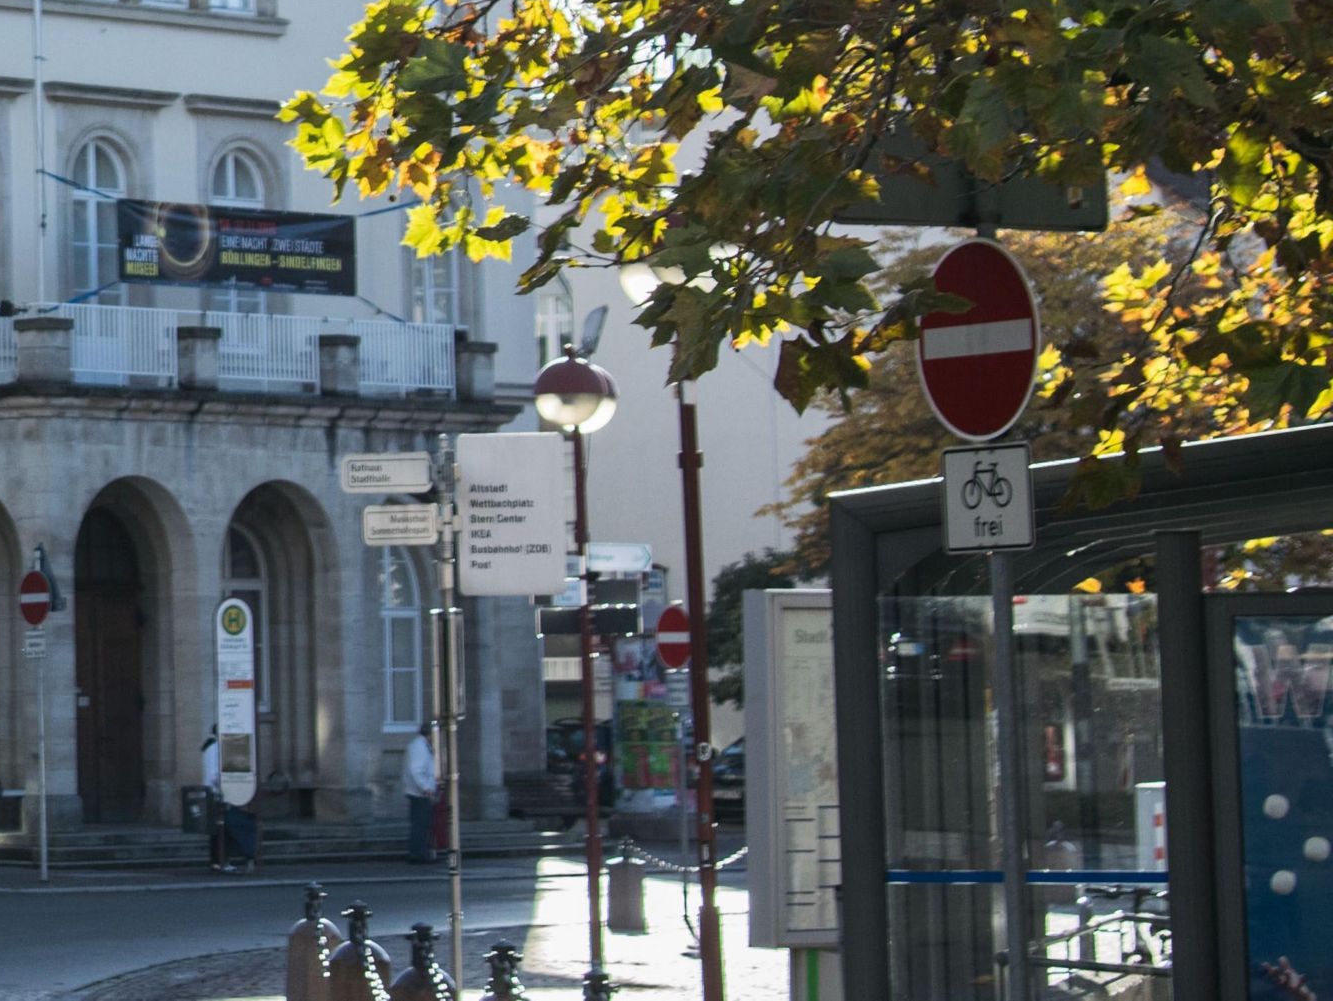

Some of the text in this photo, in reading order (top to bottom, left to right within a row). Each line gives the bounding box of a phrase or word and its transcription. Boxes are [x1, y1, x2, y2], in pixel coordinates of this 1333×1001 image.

[221, 235, 240, 248] EINE
[271, 238, 294, 252] ZWEI
[221, 250, 272, 267] BÖBLINGEN
[278, 255, 343, 272] SINDELFINGEN
[350, 474, 391, 484] Stadthalle
[469, 483, 508, 493] Altstadt
[469, 499, 535, 509] Wettbachplatz
[470, 514, 527, 524] Stern Center
[974, 515, 1004, 537] frei
[470, 529, 492, 539] IKEA
[470, 543, 552, 555] Busbahnhof (ZOB)
[470, 560, 492, 569] Post
